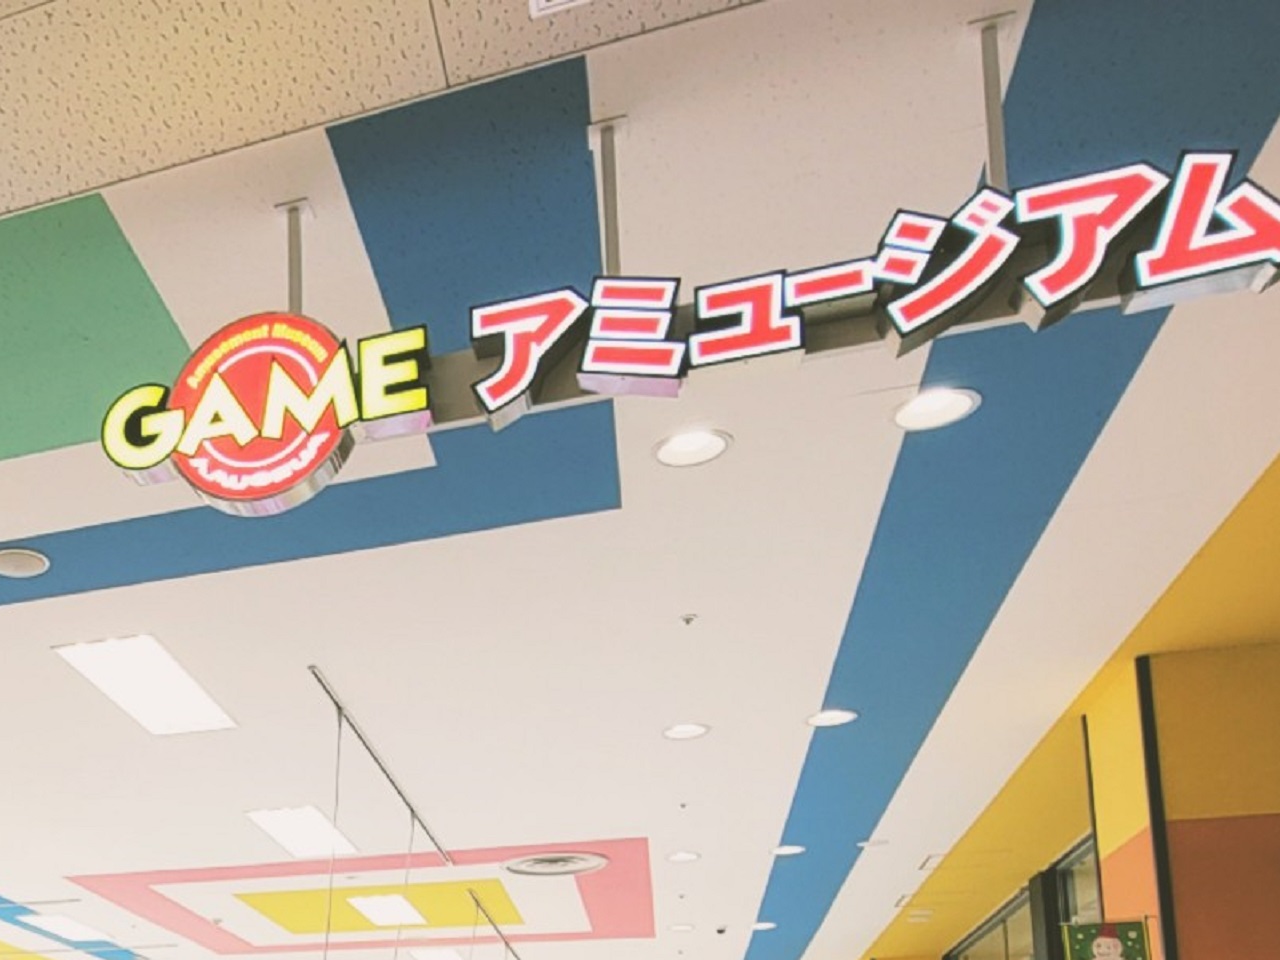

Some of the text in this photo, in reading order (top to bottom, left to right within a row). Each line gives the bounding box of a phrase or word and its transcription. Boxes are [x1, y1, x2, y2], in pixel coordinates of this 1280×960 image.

[472, 152, 1280, 412] アミュージアム
[102, 325, 429, 470] GAME
